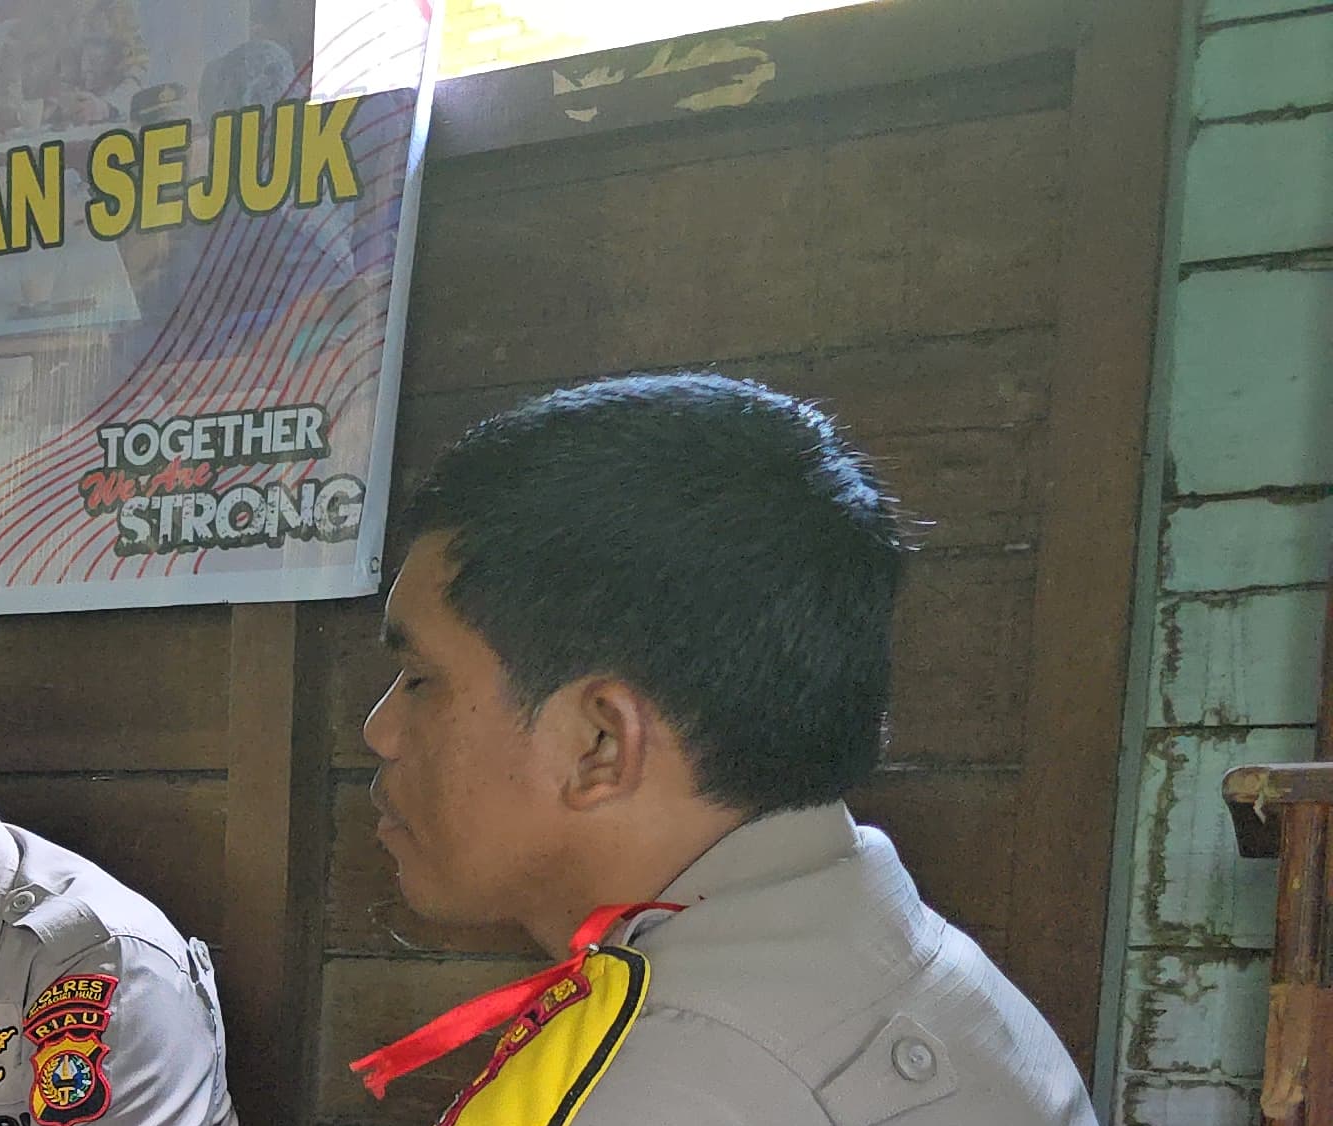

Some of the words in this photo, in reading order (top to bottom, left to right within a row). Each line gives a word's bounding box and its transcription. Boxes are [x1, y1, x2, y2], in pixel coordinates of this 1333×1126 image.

[87, 98, 363, 240] SEJUK
[99, 405, 327, 470] TOGETHER
[83, 470, 135, 508] We
[146, 457, 211, 492] Are
[118, 476, 365, 548] STRONG
[35, 1012, 98, 1038] RIAU
